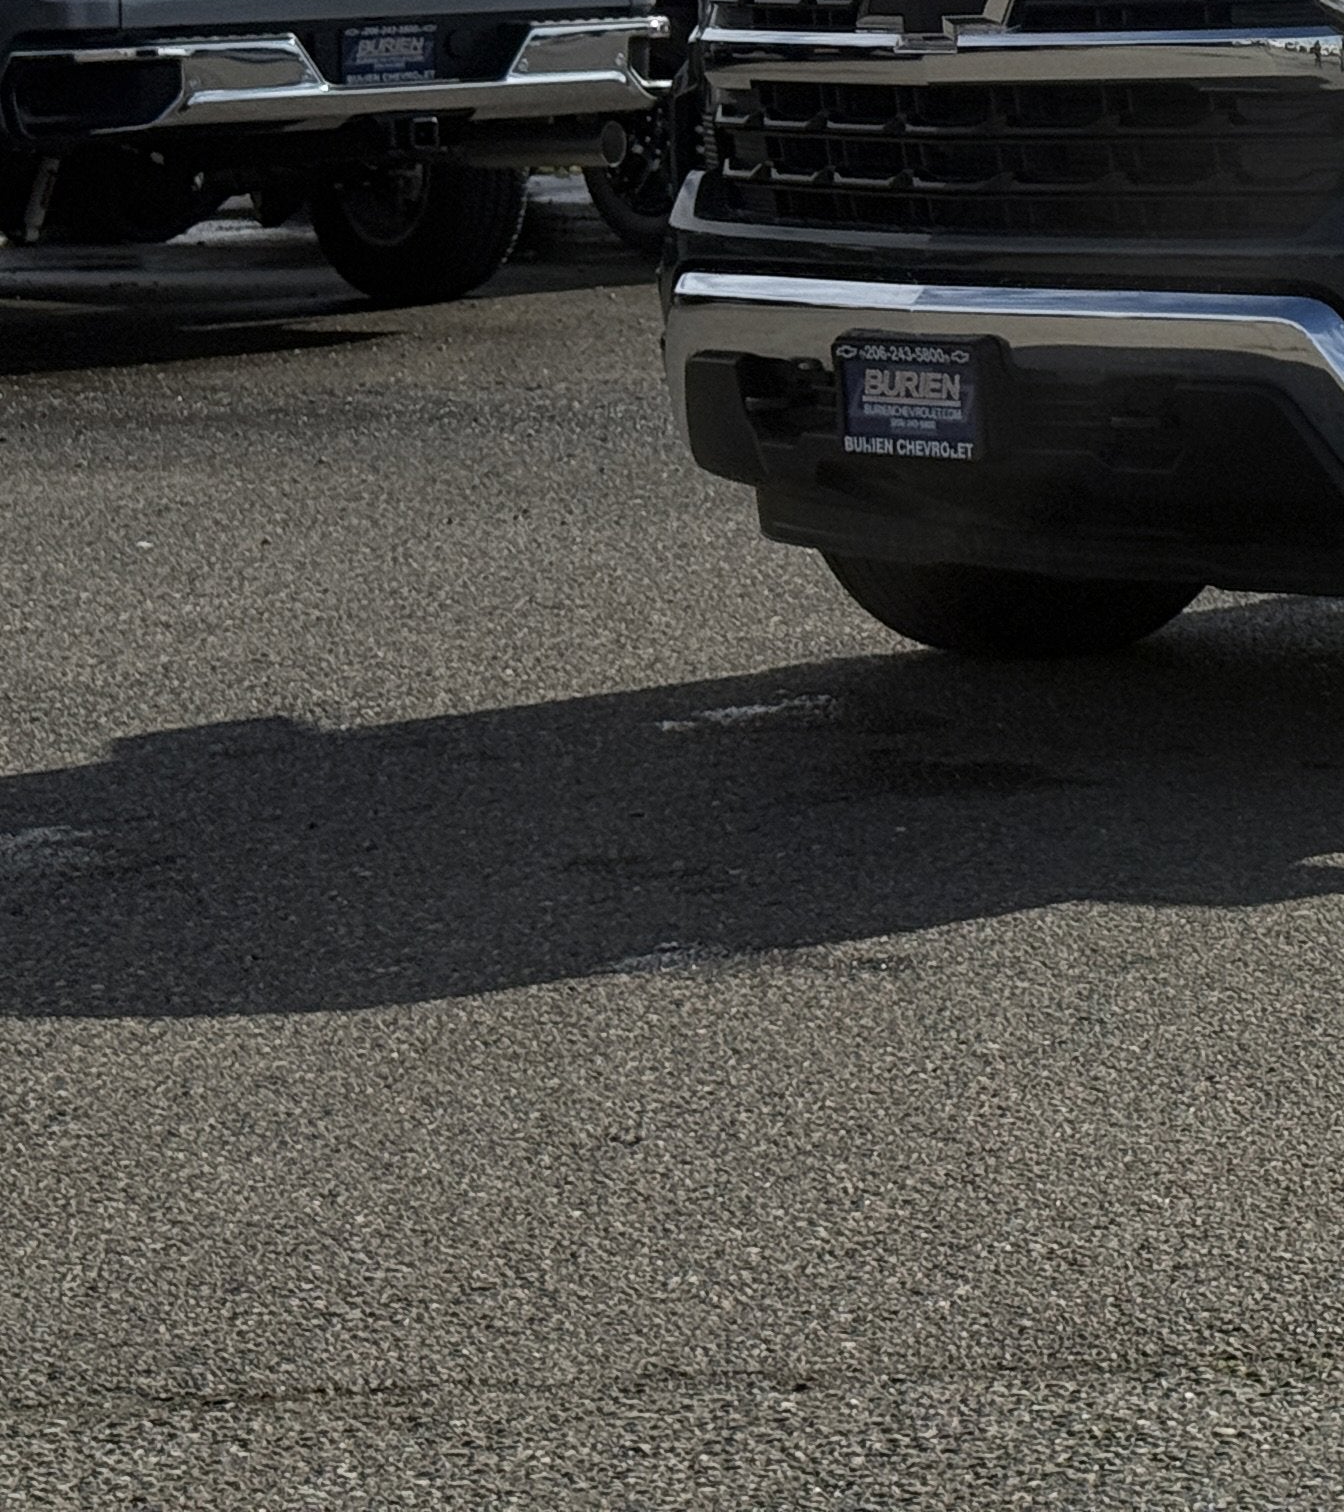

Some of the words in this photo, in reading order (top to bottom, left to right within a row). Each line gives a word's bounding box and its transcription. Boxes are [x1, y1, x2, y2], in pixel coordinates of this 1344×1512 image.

[358, 37, 424, 55] BURIEN
[863, 345, 945, 363] 206-243-5800
[864, 368, 961, 400] BURIEN
[844, 435, 894, 455] BURIEN
